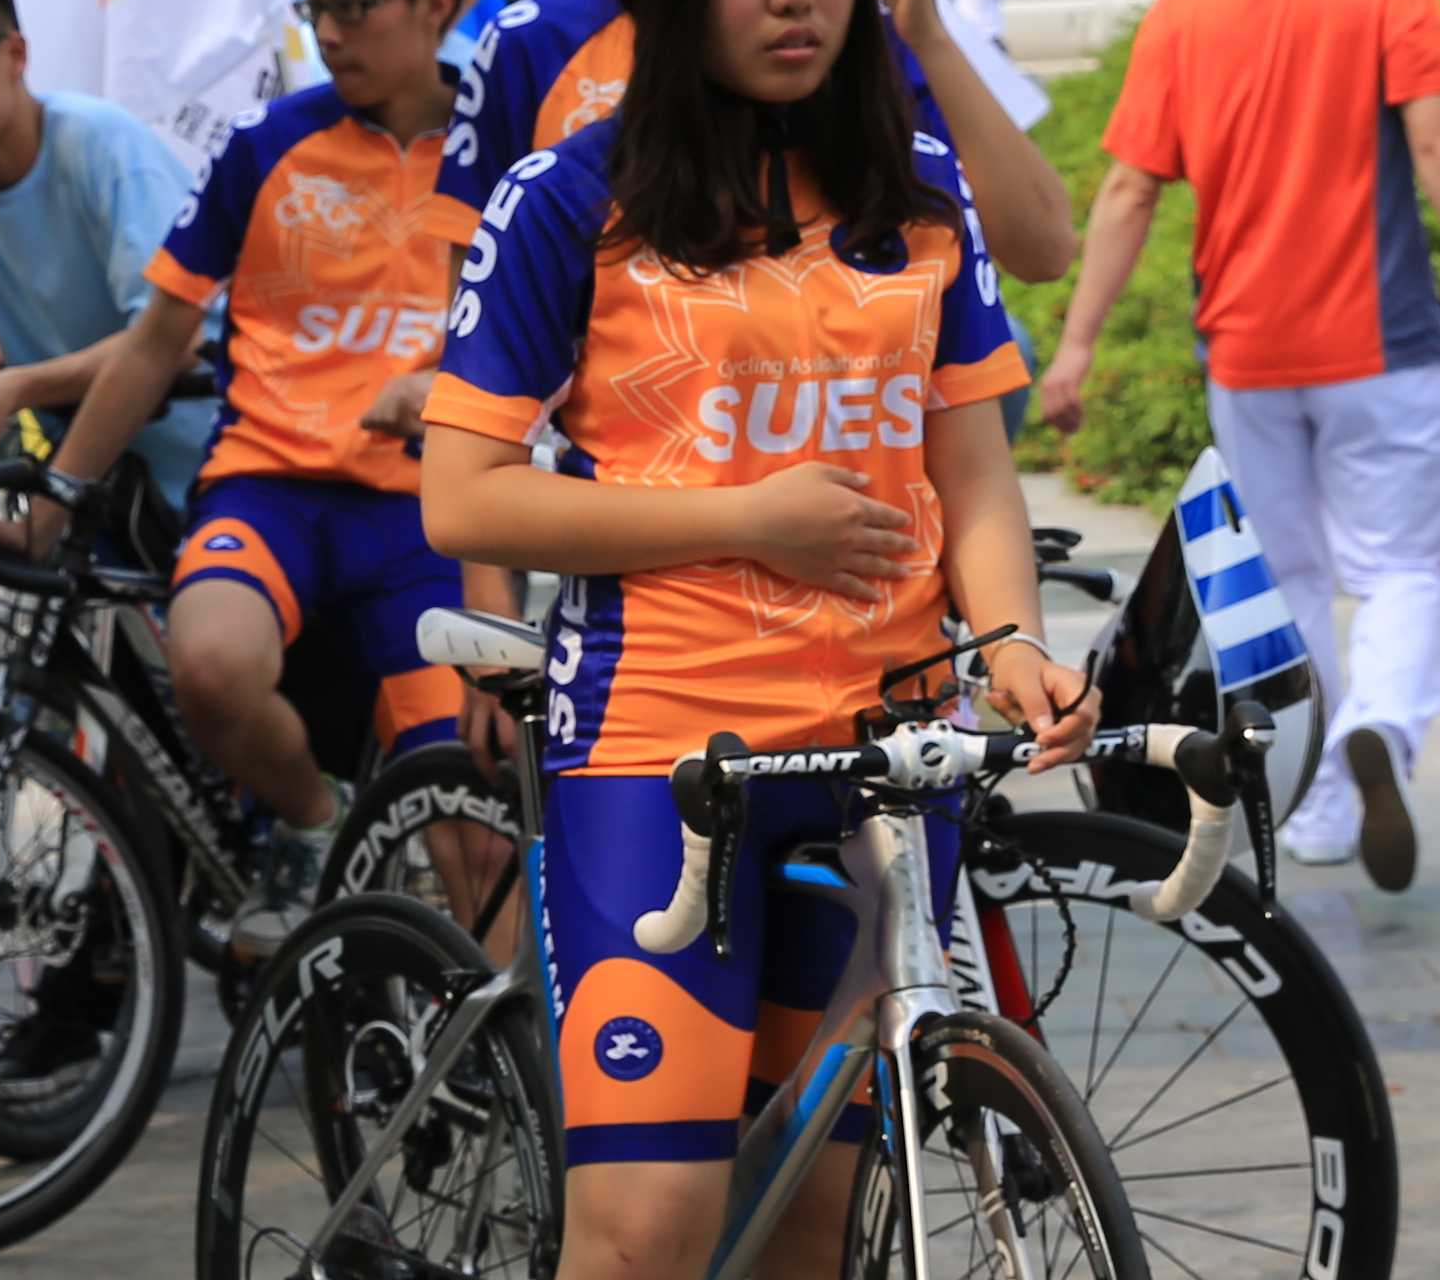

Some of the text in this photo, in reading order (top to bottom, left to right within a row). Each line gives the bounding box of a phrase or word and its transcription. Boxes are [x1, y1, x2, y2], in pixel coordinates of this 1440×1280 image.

[448, 149, 558, 338] SUES
[696, 373, 924, 463] SUES
[747, 750, 862, 776] GIANT
[1011, 735, 1124, 763] GNT
